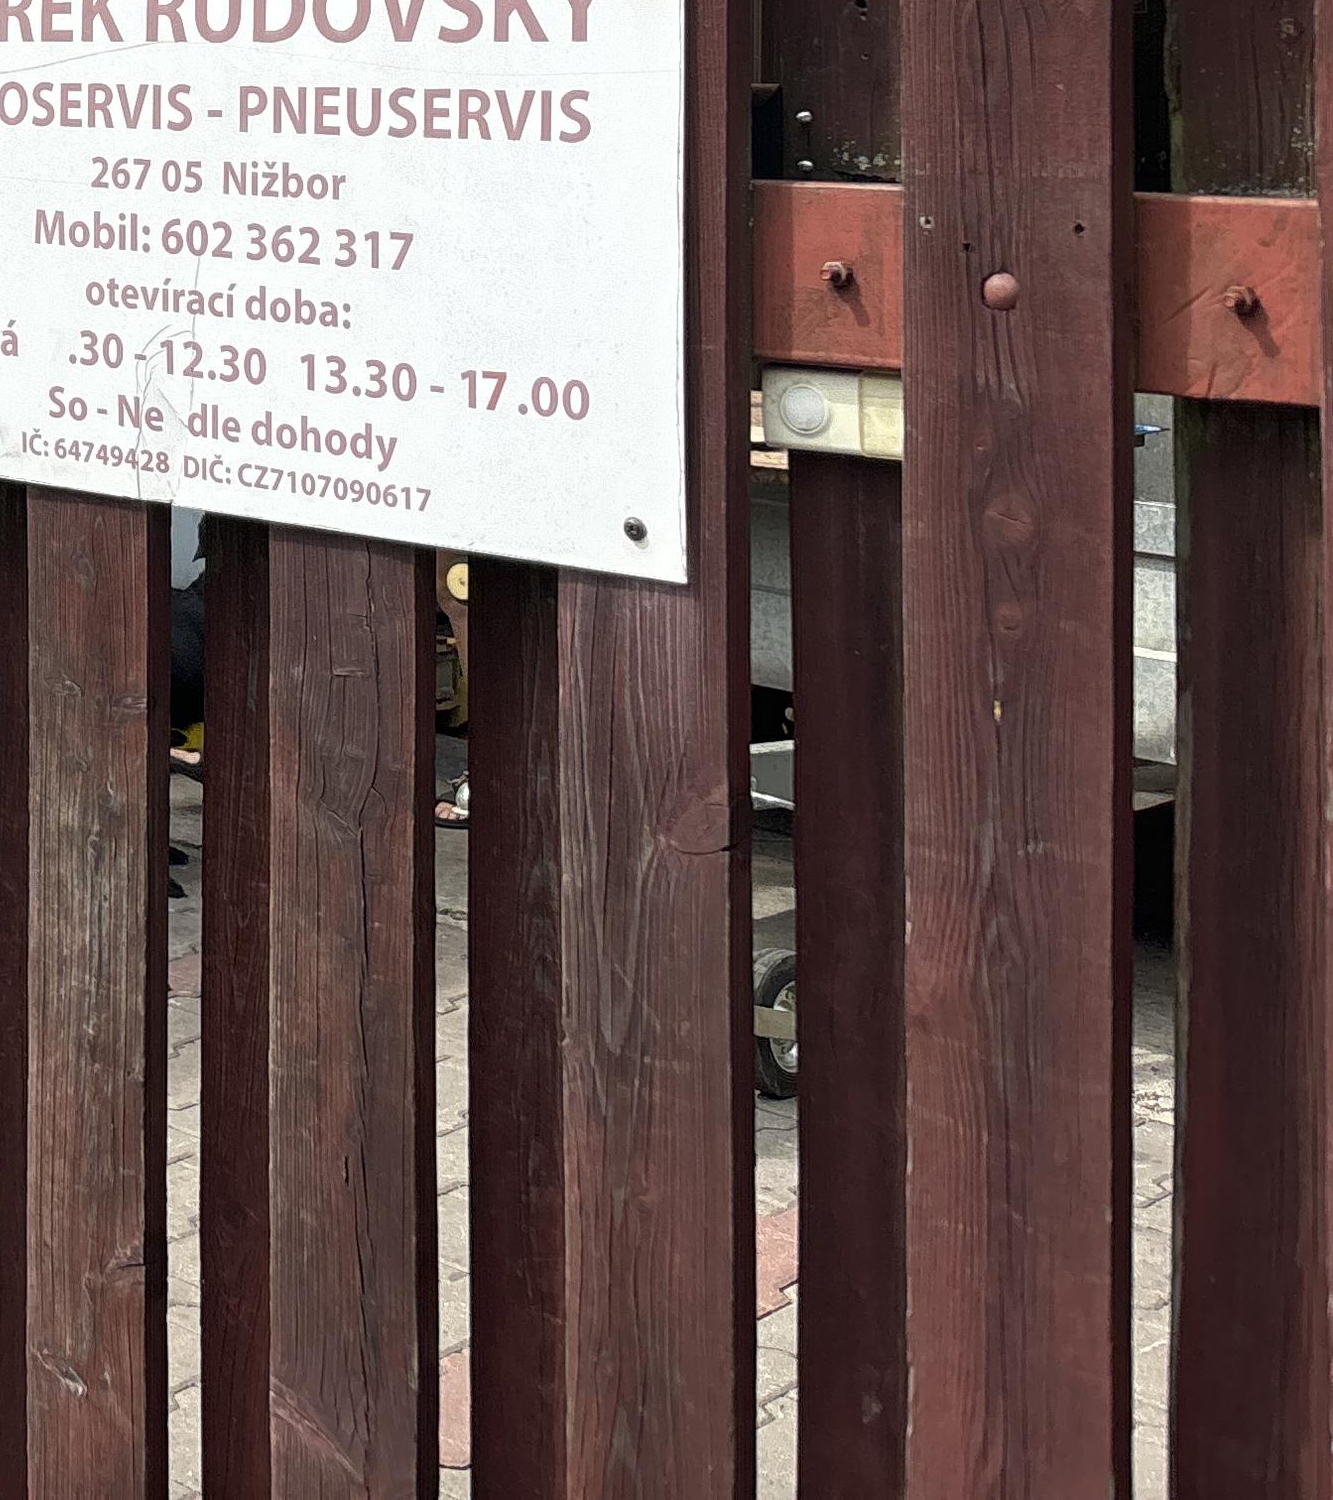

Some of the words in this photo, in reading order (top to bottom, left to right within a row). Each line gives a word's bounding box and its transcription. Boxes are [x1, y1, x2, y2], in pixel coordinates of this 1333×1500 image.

[238, 84, 593, 144] PNEUSERVIS
[90, 156, 152, 191] 267
[161, 159, 204, 194] 05
[222, 160, 347, 201] Nižbor
[34, 208, 151, 254] Mobil:
[160, 217, 233, 260] 602
[246, 222, 321, 266] 362
[334, 228, 415, 271] 317
[85, 277, 238, 319] otevírací
[244, 285, 352, 331] doba:
[159, 338, 267, 386] 12.30
[299, 353, 418, 402] 13.30
[48, 385, 88, 421] So
[117, 393, 165, 432] Ne
[187, 402, 242, 444] dle
[250, 410, 398, 472] dohody
[21, 428, 50, 457] IČ:
[53, 438, 171, 475] 64749428
[183, 453, 232, 486] DIČ:
[237, 462, 432, 513] CZ7107090617
